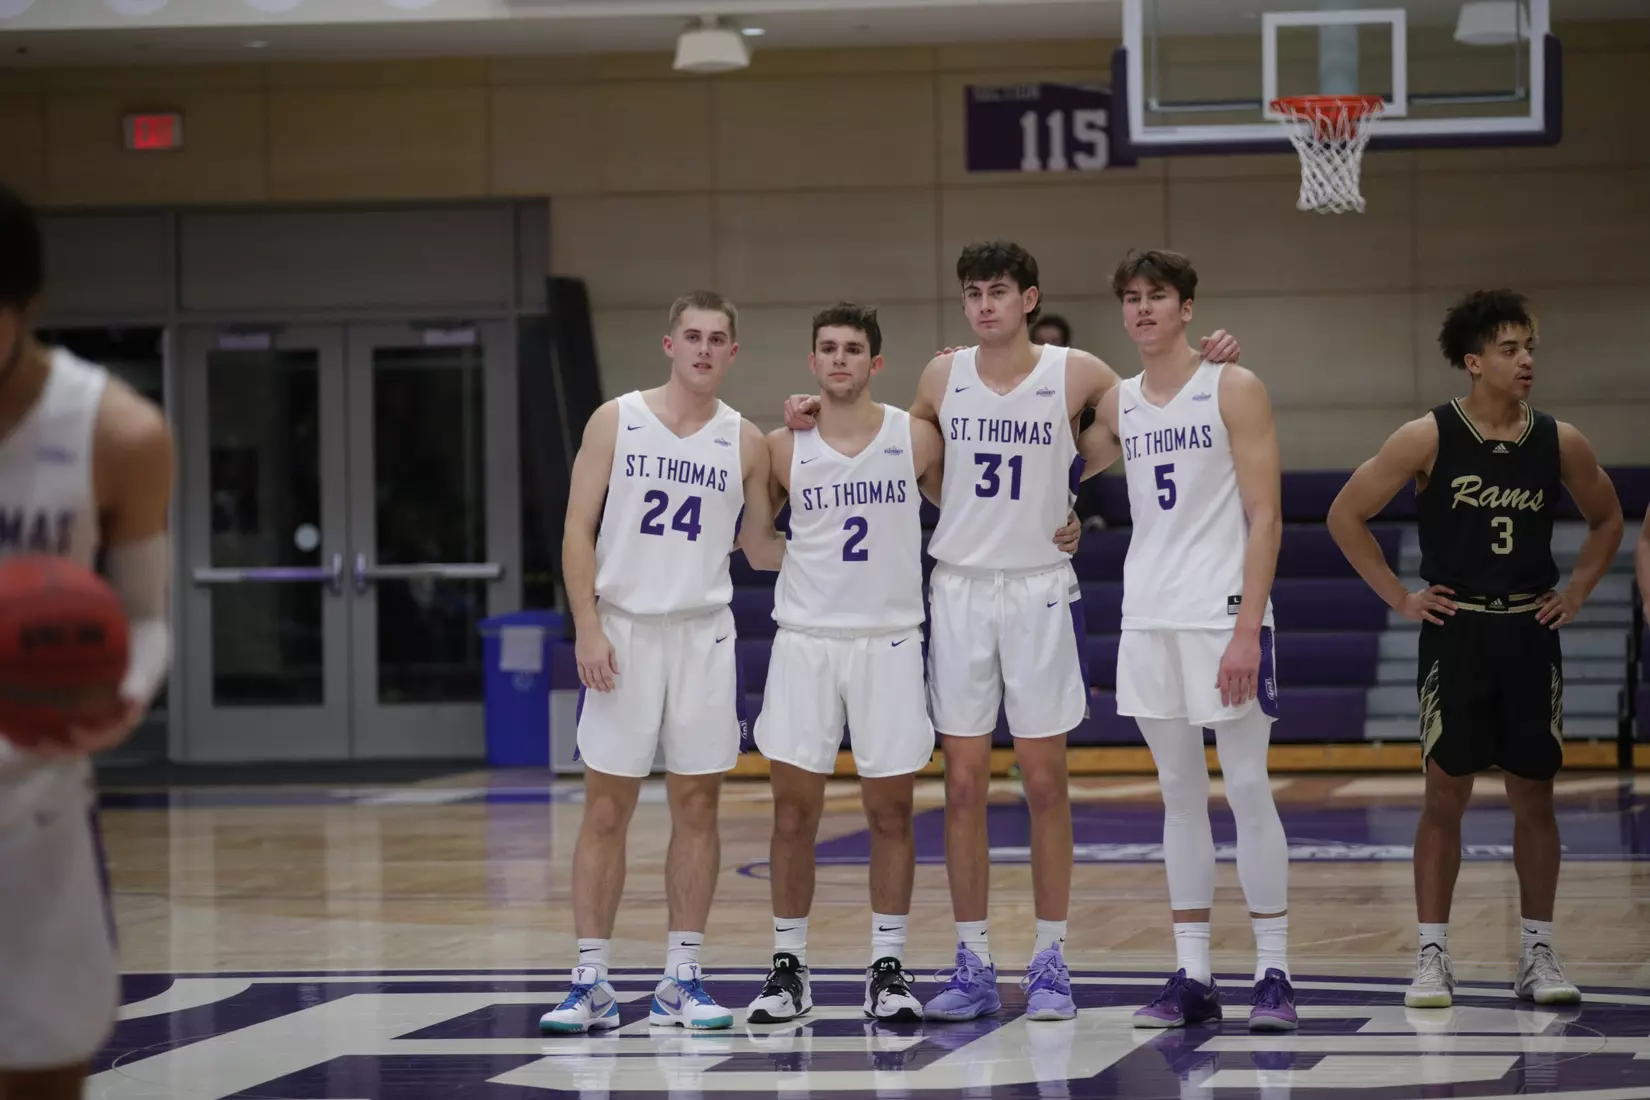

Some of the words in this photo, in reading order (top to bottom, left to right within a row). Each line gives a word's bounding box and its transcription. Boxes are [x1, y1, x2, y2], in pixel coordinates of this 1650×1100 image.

[1020, 111, 1107, 172] 115
[951, 417, 975, 442] ST.
[977, 418, 1052, 446] THOMAS
[1125, 435, 1143, 461] ST.
[1144, 424, 1213, 456] THOMAS
[626, 454, 650, 478] ST.
[656, 456, 728, 493] THOMAS
[973, 452, 1023, 500] 31
[1154, 462, 1177, 511] 5
[1451, 474, 1545, 511] Rams
[803, 486, 829, 511] ST.
[832, 479, 906, 507] THOMAS
[639, 489, 702, 542] 24
[1491, 516, 1513, 554] 3
[842, 516, 869, 562] 2
